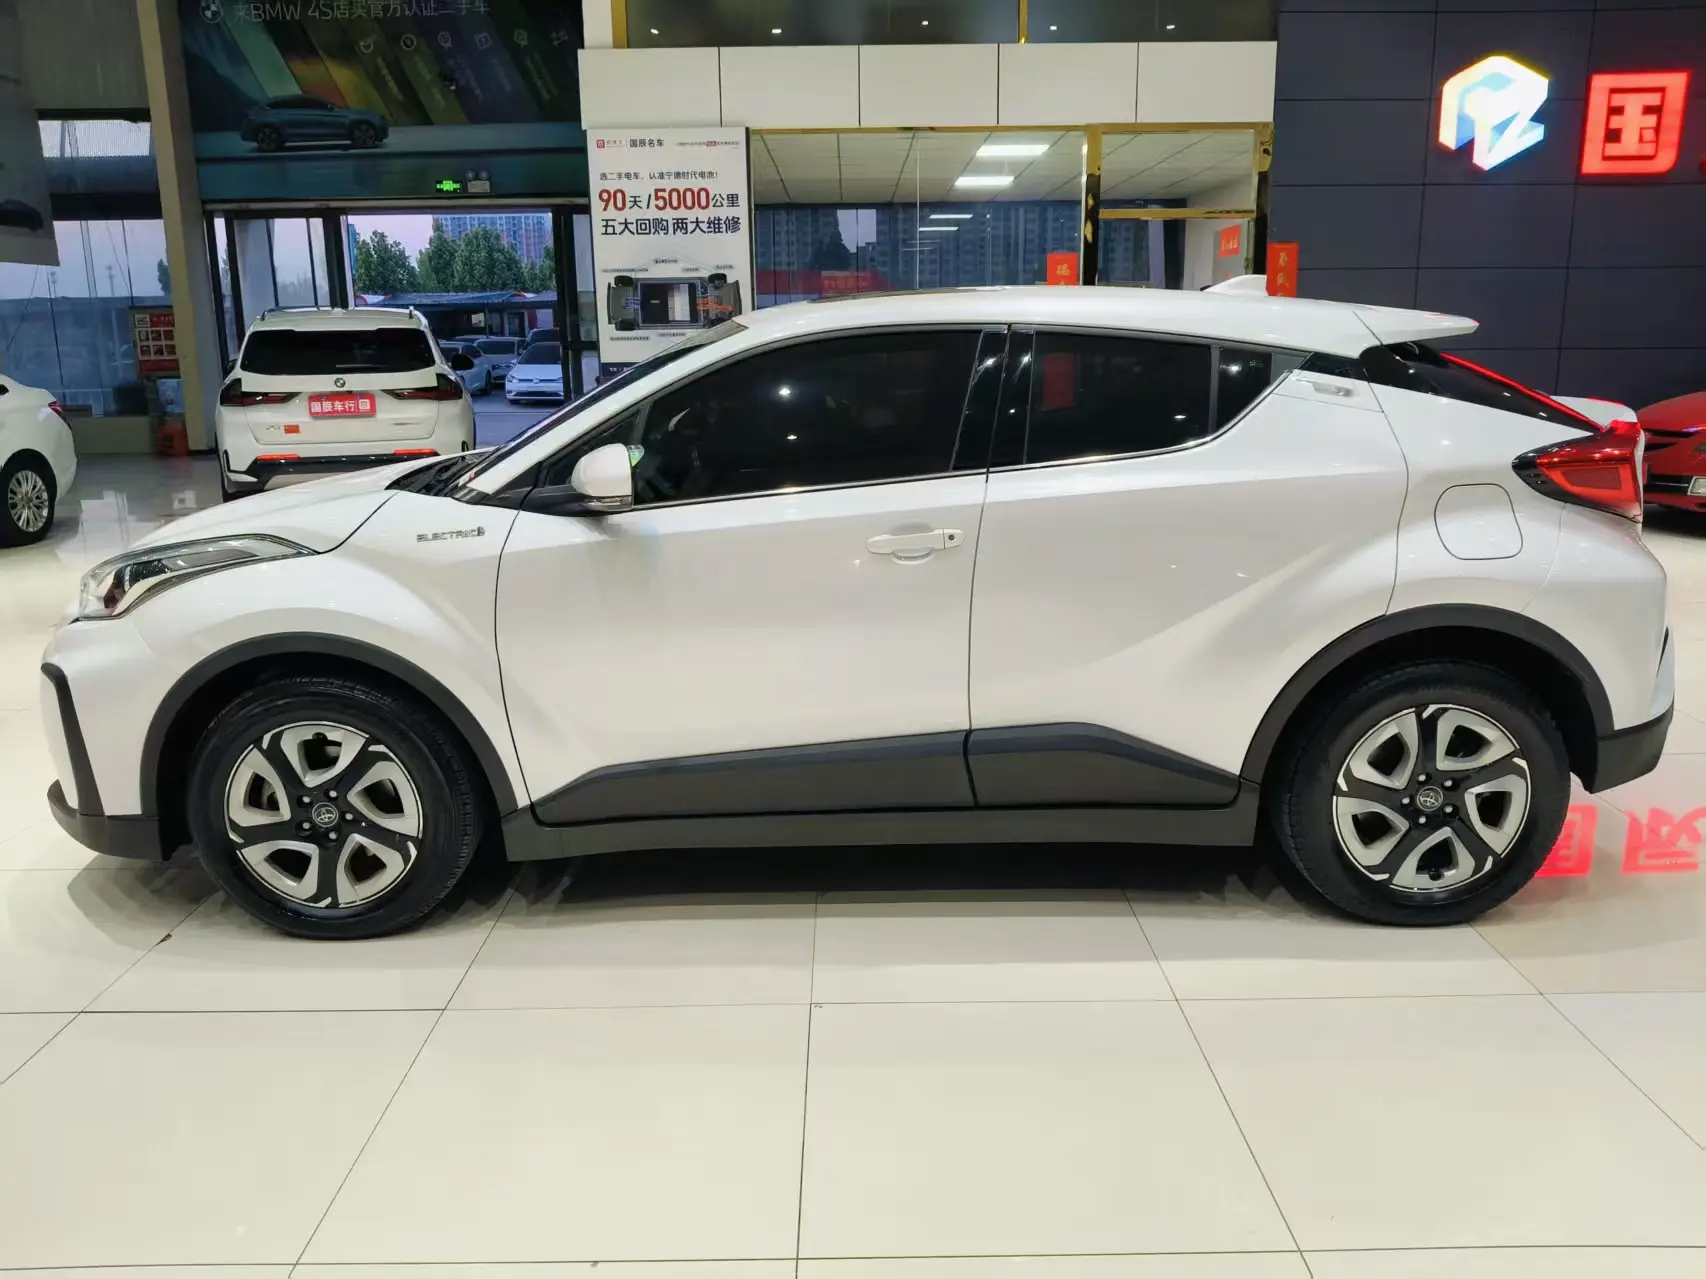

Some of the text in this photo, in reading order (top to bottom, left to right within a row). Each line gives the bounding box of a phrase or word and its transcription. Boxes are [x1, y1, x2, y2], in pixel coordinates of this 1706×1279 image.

[629, 138, 665, 148] 国辰名车
[600, 215, 741, 236] 五大回购 两大维修
